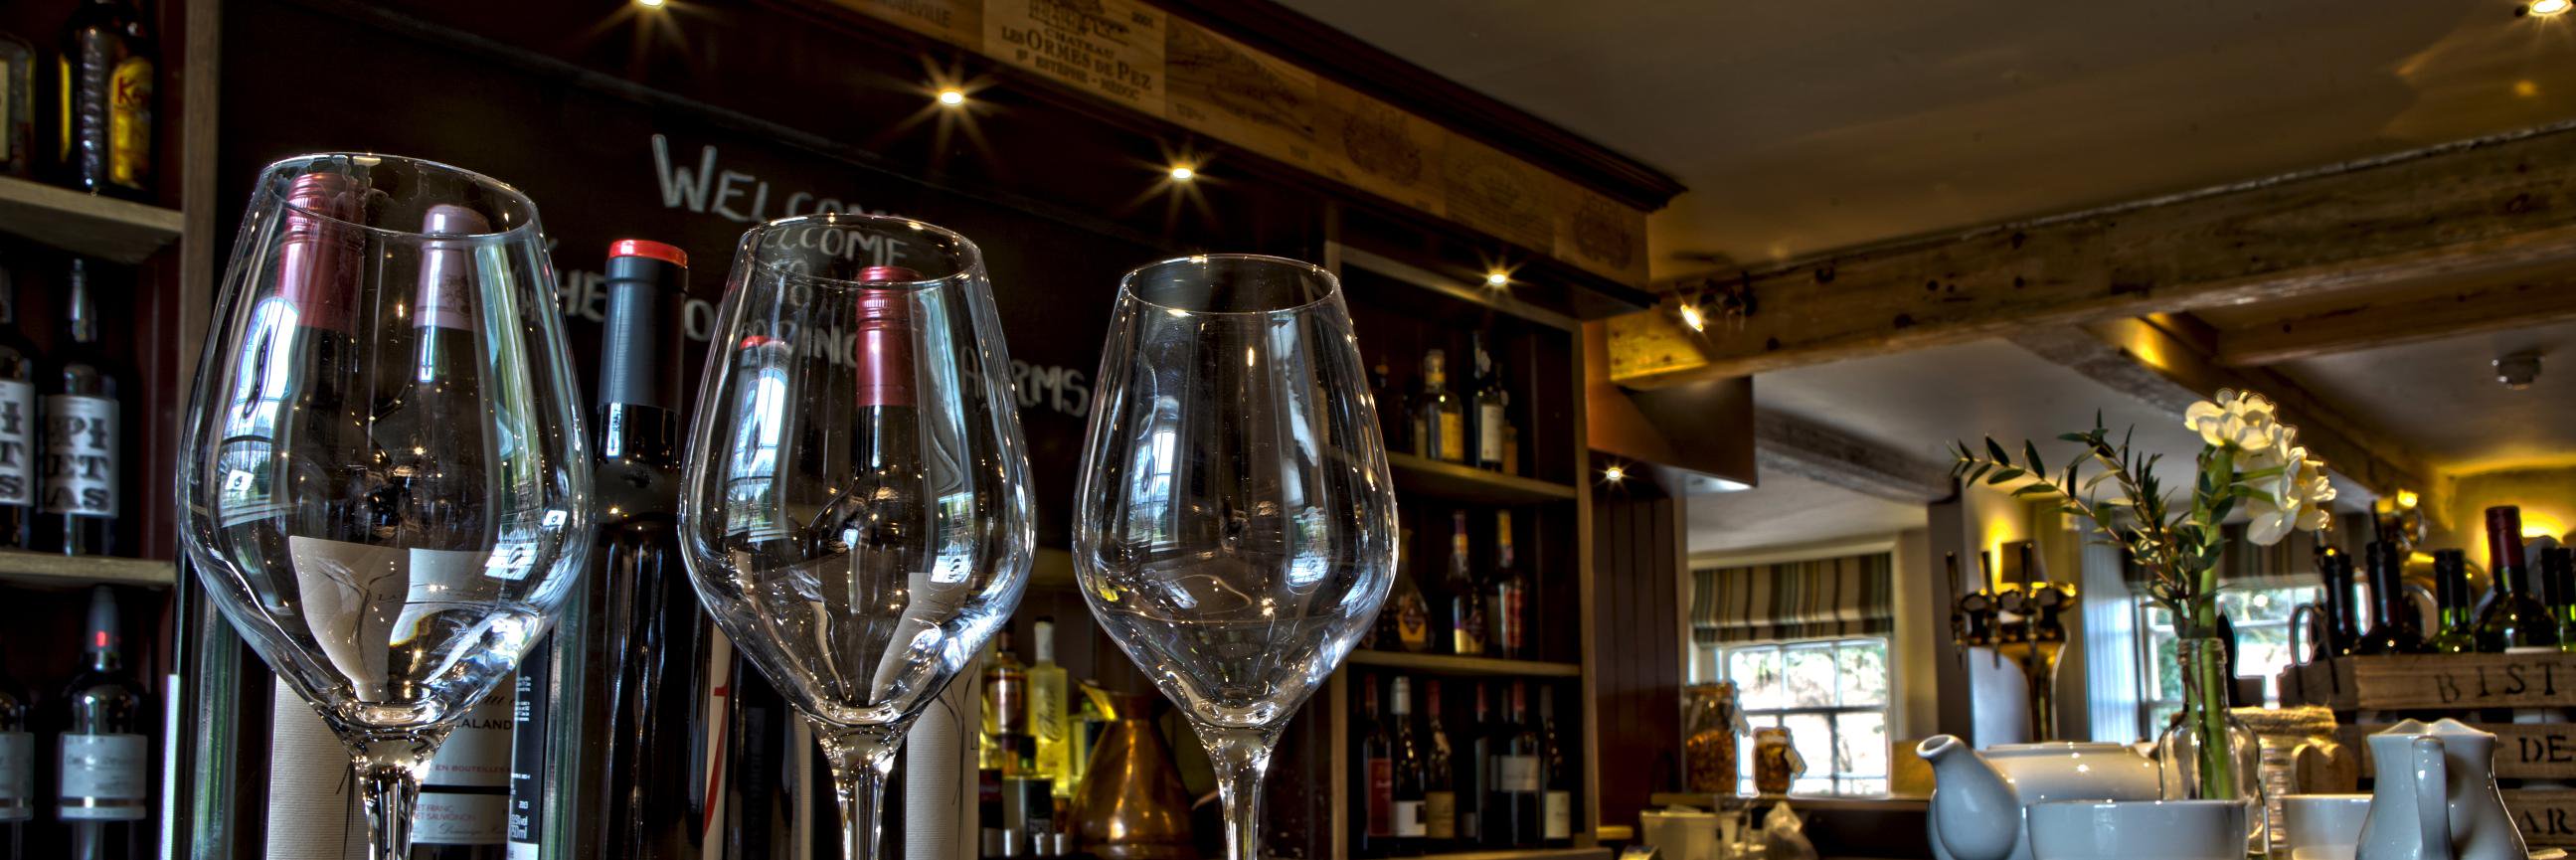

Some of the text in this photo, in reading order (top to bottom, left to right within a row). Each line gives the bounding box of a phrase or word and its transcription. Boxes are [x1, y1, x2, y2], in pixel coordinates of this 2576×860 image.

[1026, 28, 1092, 69] ORMES
[1095, 60, 1115, 77] DE
[1116, 61, 1152, 91] PEZ
[2435, 660, 2576, 704] BIST
[457, 718, 512, 732] ALAND
[2518, 735, 2573, 765] DE
